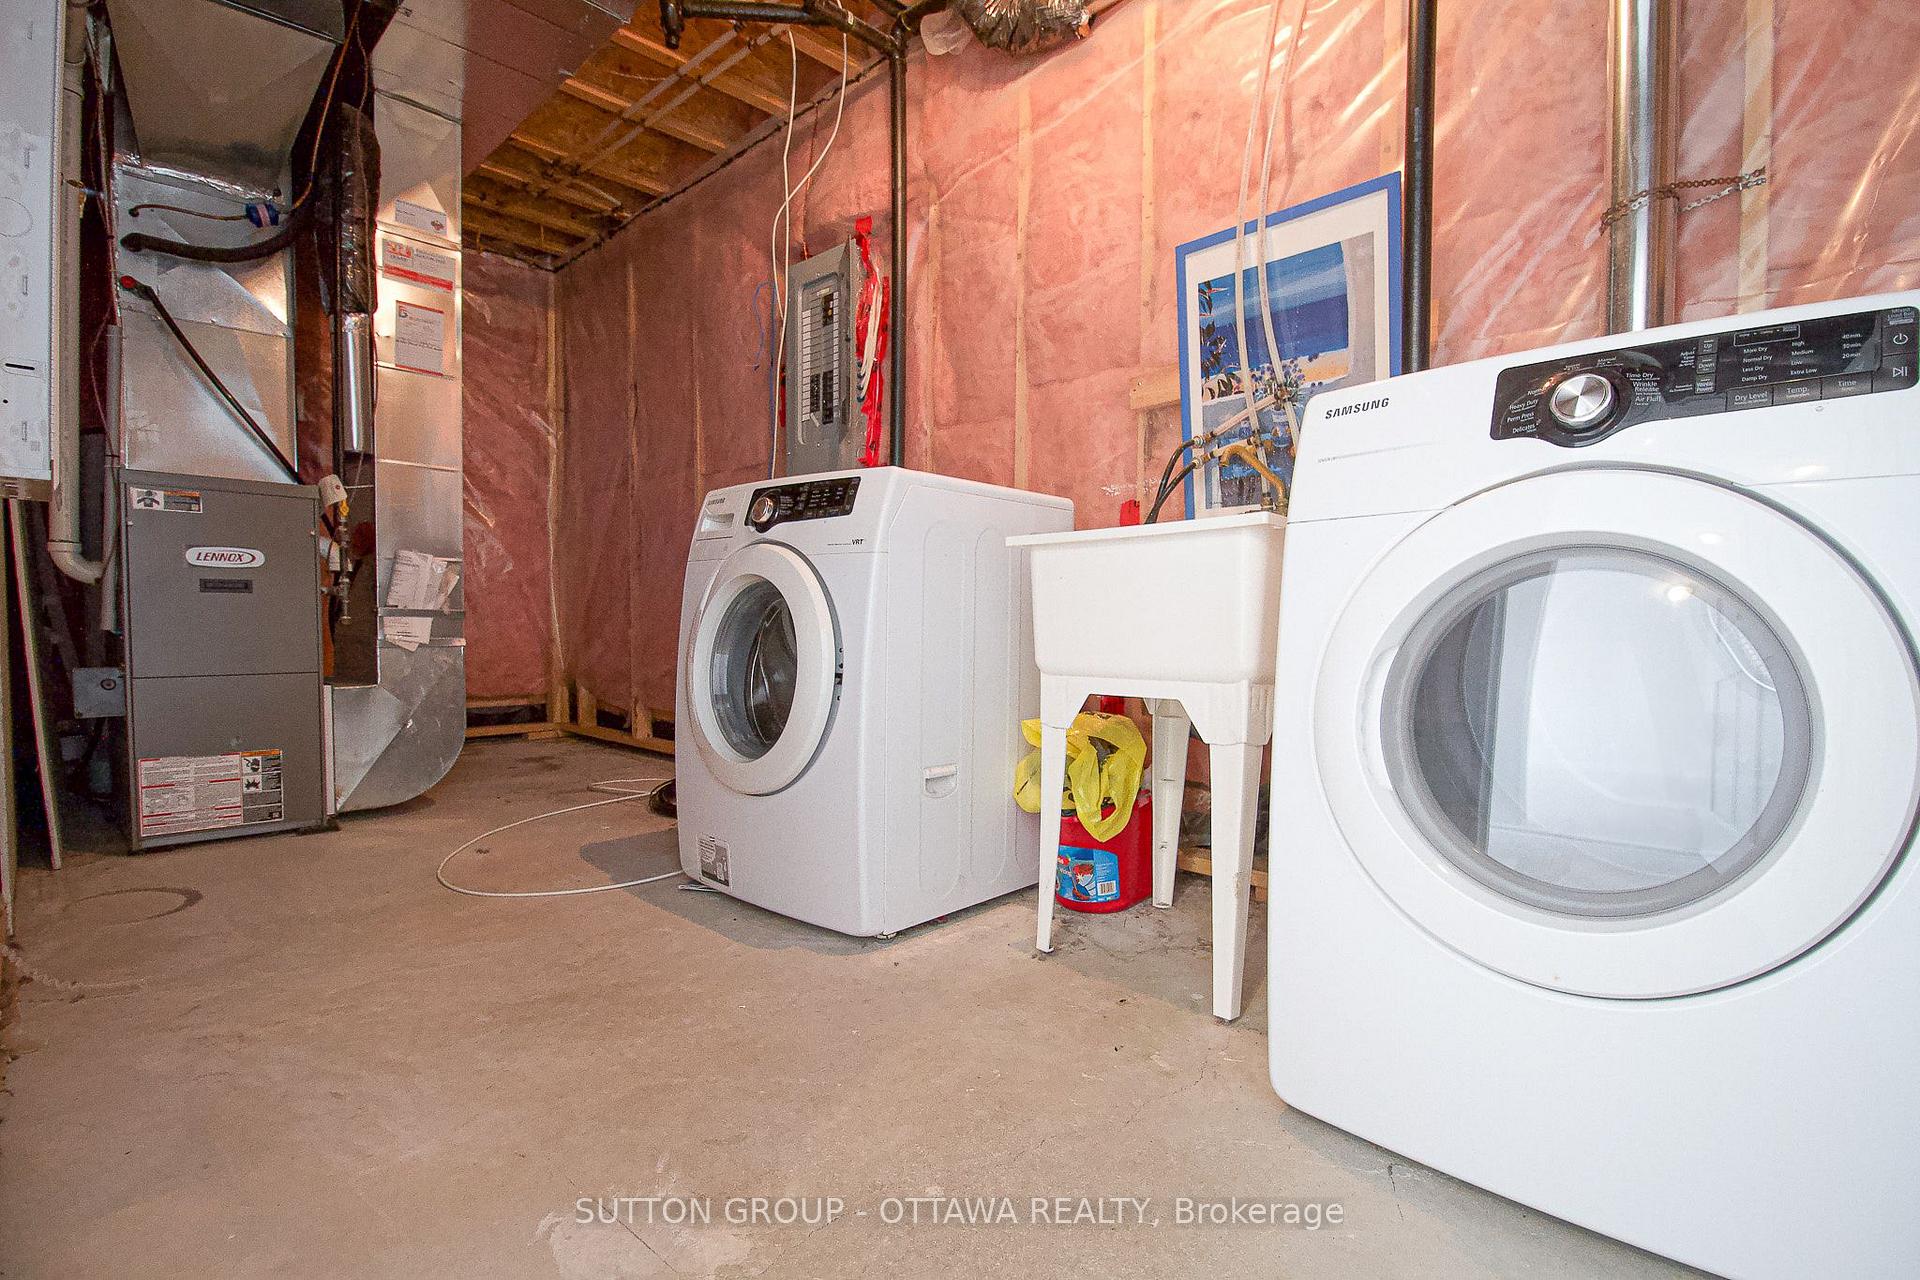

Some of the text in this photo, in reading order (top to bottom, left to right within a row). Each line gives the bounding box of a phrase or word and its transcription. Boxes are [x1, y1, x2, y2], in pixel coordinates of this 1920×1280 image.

[1838, 379, 1857, 387] Time
[1787, 386, 1810, 395] Temp.
[1734, 391, 1768, 402] Dry Level
[1325, 397, 1390, 420] SAMSUNG
[1509, 401, 1525, 411] Heavy
[1526, 399, 1539, 407] Duty
[1507, 415, 1521, 423] Perm
[1512, 423, 1536, 434] Delicates
[851, 538, 864, 546] VRT
[196, 552, 244, 563] LENNOX
